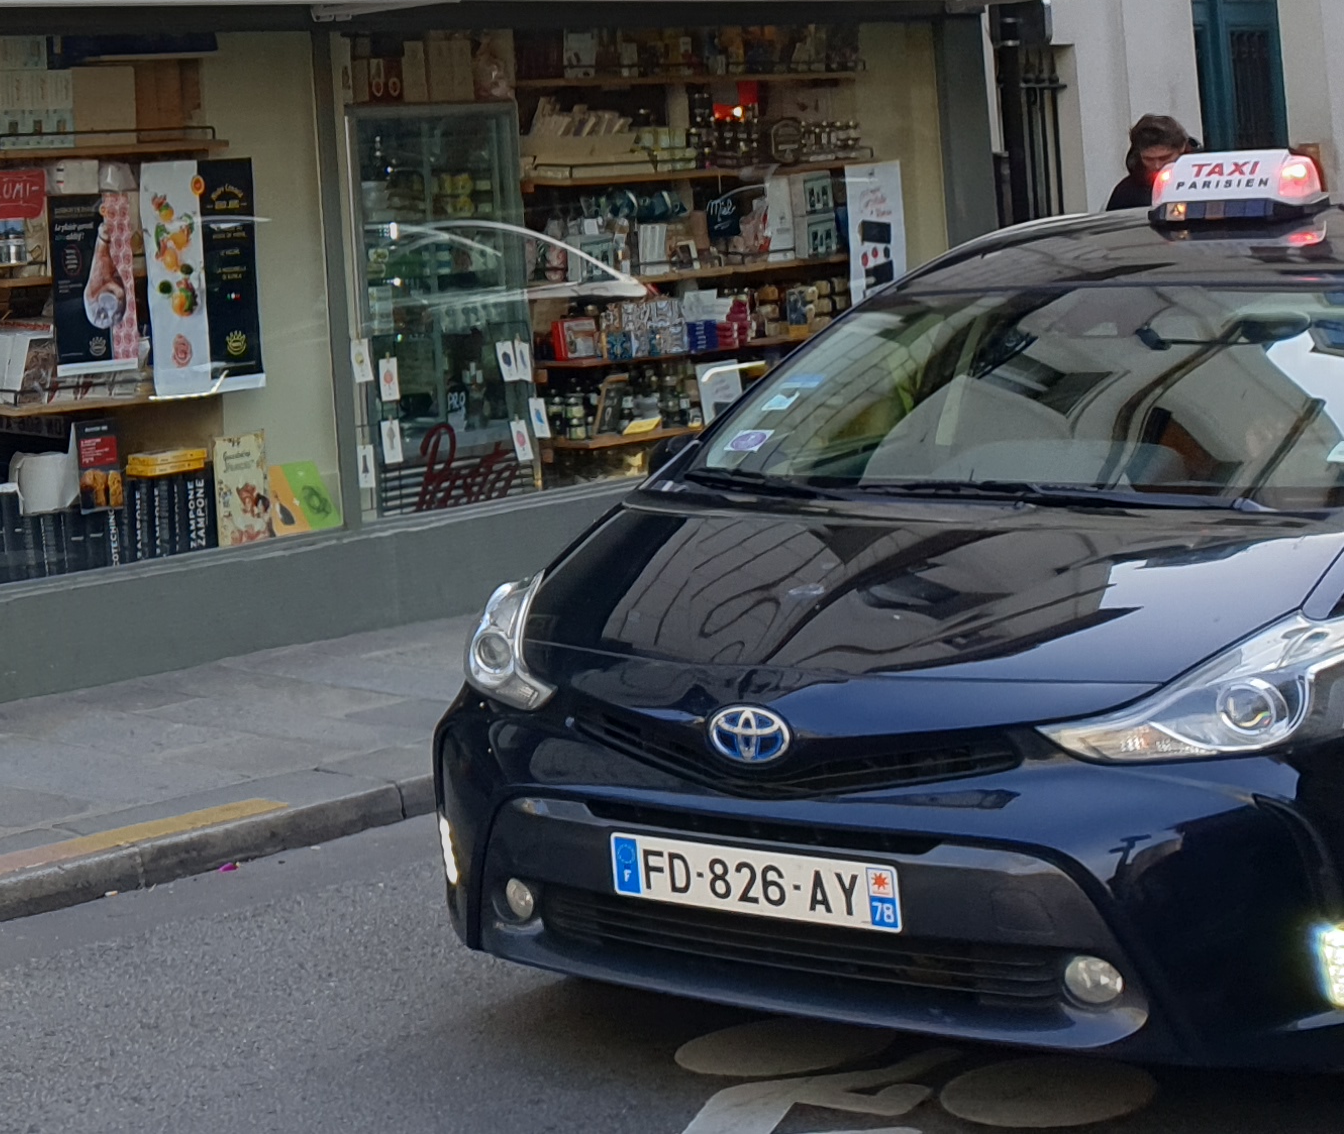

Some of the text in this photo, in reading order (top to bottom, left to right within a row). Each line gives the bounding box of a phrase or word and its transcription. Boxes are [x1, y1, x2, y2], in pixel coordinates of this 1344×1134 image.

[1190, 160, 1260, 178] TAXI
[1175, 177, 1269, 191] PARISIEN
[187, 480, 197, 549] ZAMPONE
[195, 478, 206, 547] ZAMPONE
[624, 869, 632, 882] F
[642, 848, 859, 917] FD-826-AY
[873, 901, 895, 923] 78
